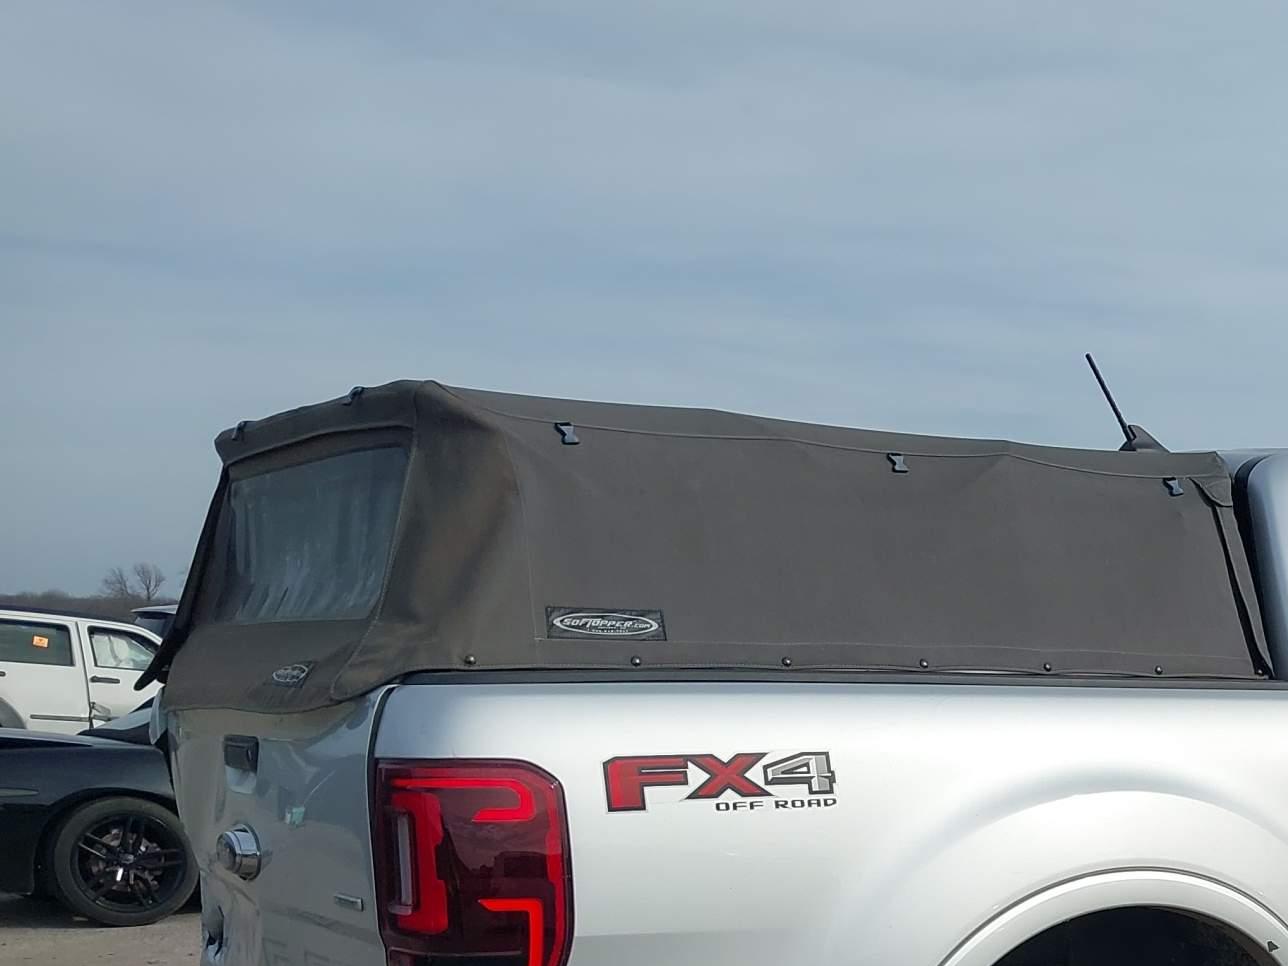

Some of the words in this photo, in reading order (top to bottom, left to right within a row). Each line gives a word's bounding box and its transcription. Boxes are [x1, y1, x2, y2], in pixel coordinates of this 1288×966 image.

[602, 751, 837, 812] FX4
[715, 801, 764, 812] OFF
[775, 798, 838, 810] ROAD
